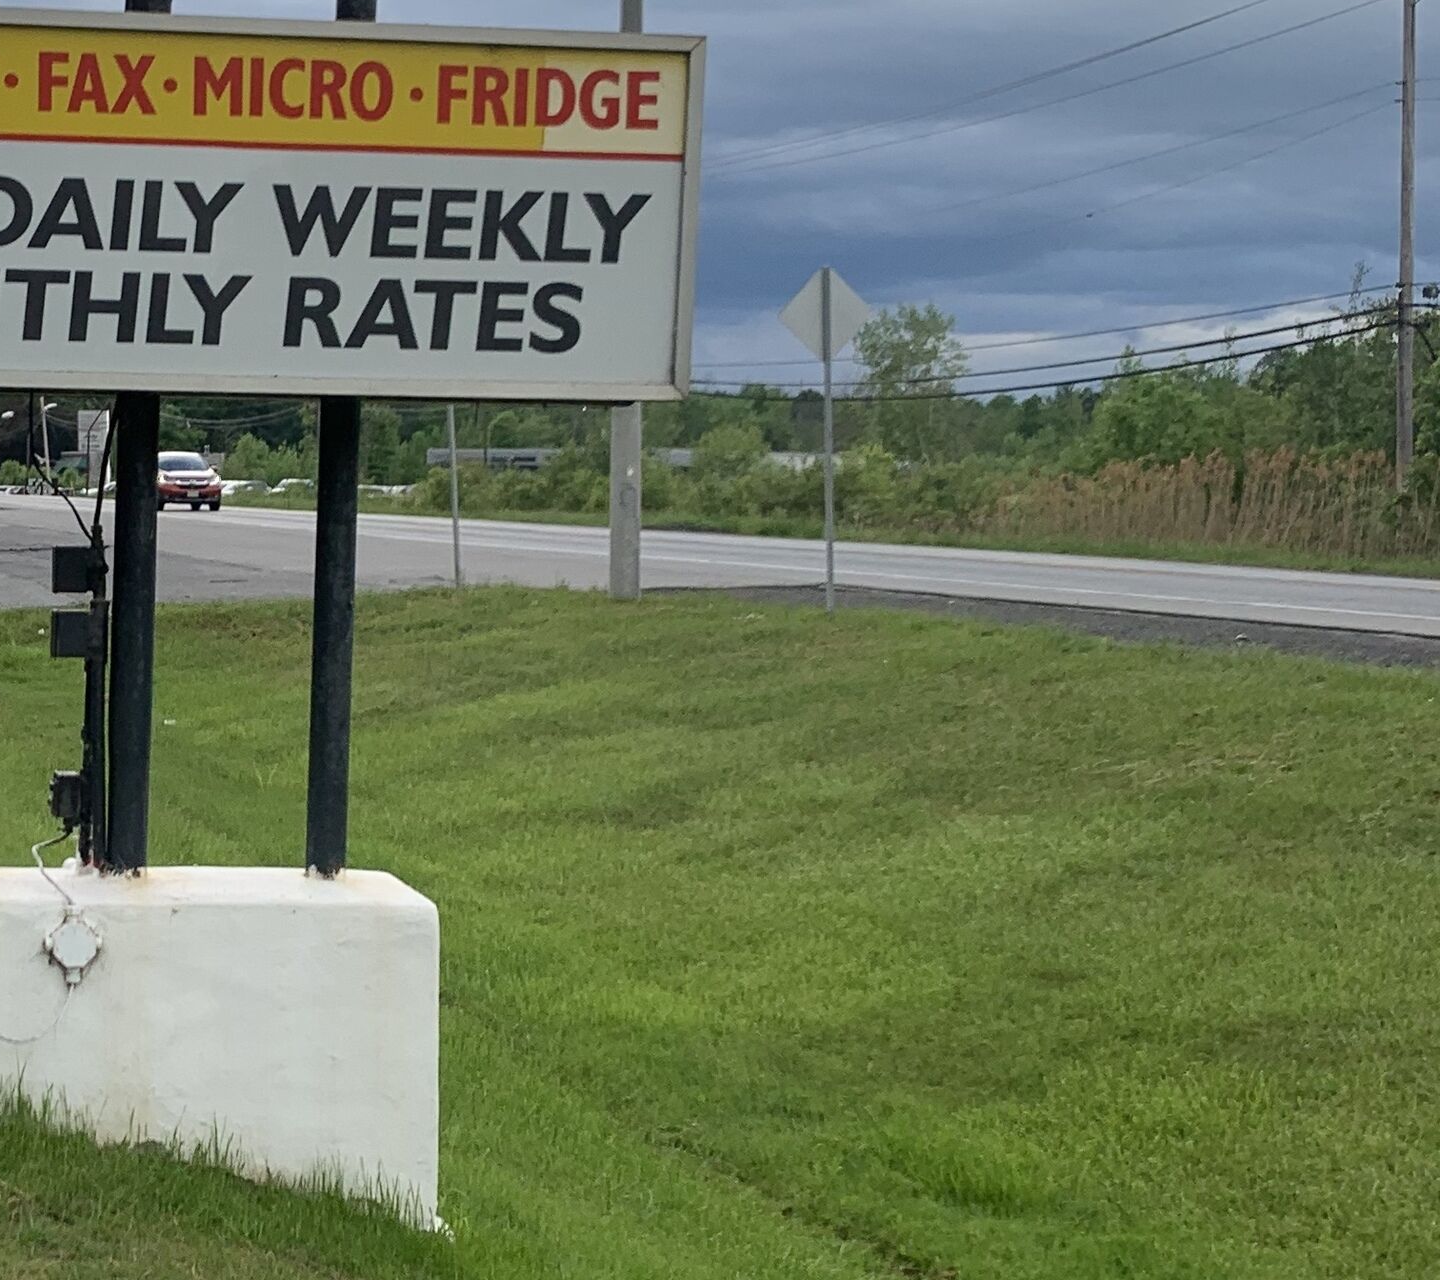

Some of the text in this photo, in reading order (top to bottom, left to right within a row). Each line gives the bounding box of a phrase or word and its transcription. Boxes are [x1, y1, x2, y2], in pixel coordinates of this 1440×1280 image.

[37, 52, 157, 115] FAX
[193, 56, 394, 121] MICRO
[436, 65, 660, 130] FRIDGE
[272, 183, 653, 265] WEEKLY
[282, 276, 585, 355] RATES
